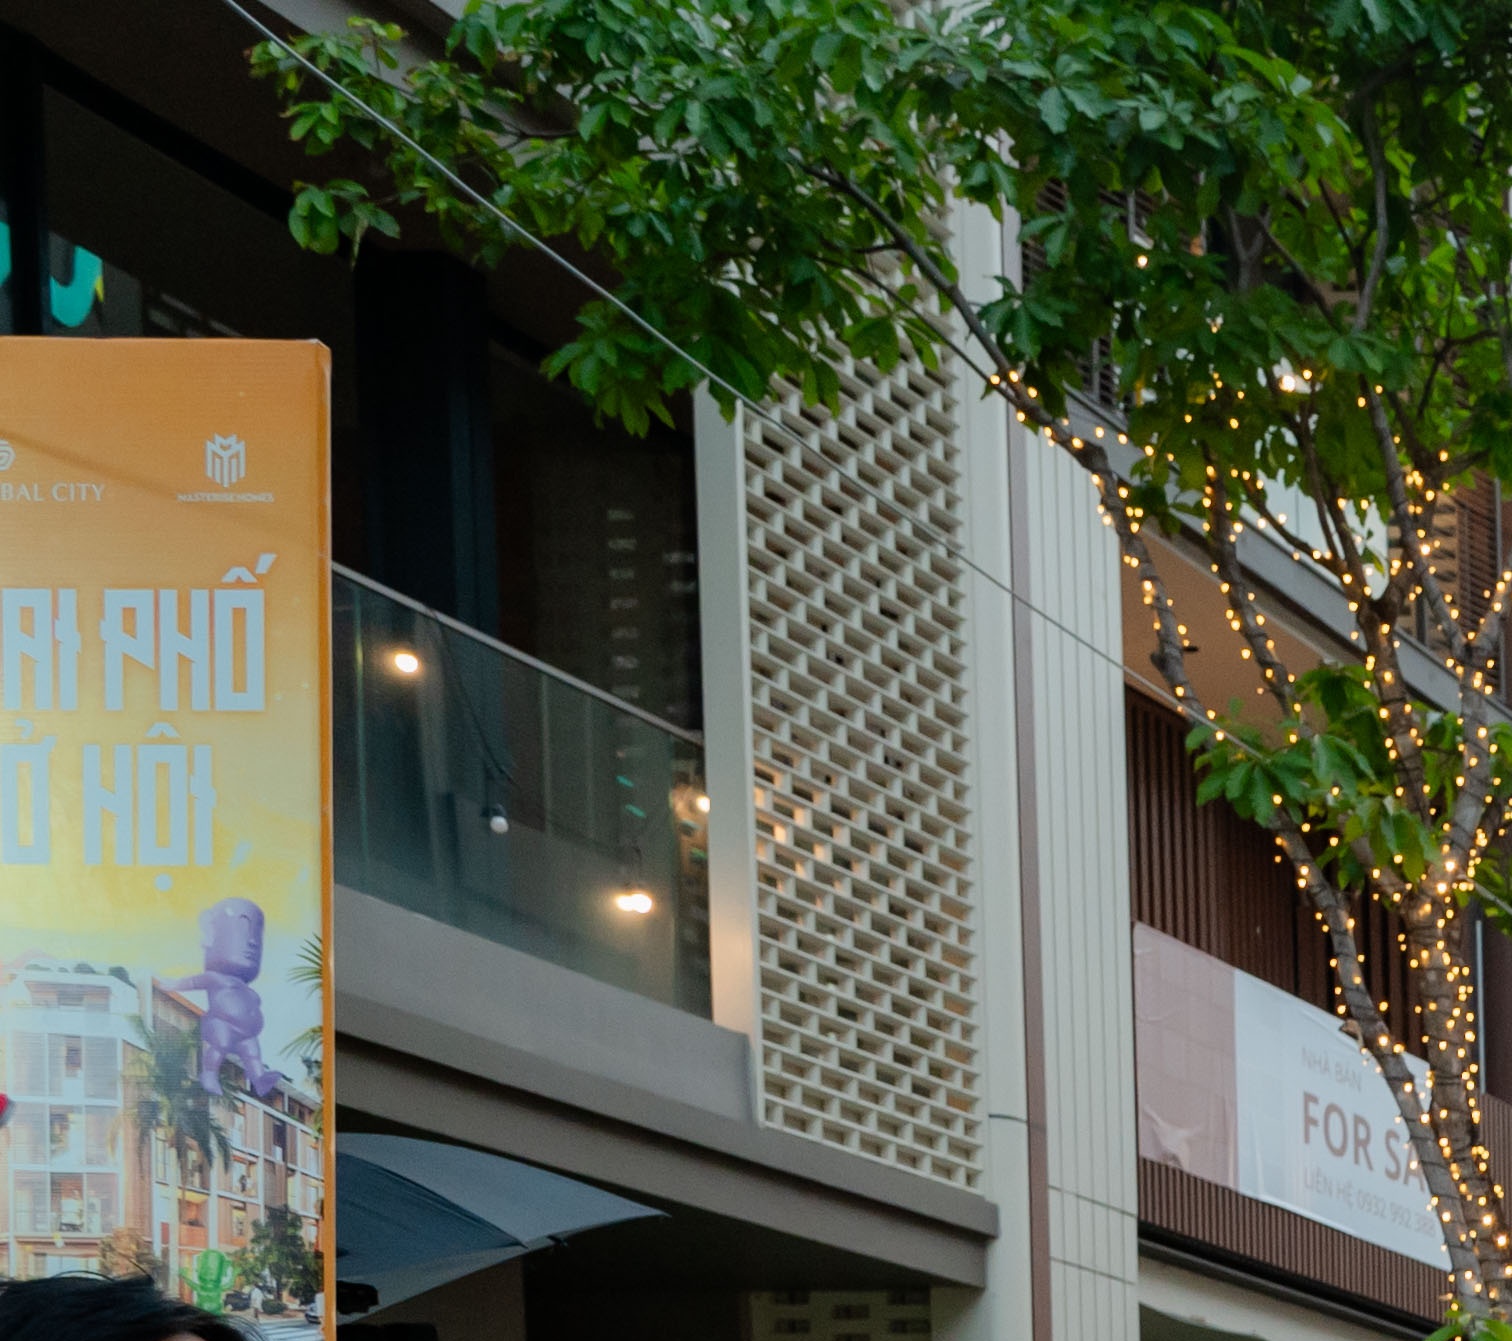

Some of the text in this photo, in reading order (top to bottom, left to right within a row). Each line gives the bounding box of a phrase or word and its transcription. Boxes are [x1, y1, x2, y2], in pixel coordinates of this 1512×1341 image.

[51, 482, 106, 501] CITY
[100, 552, 278, 711] PHỐ
[83, 721, 217, 892] HỘI
[1303, 1090, 1427, 1193] FOR SA
